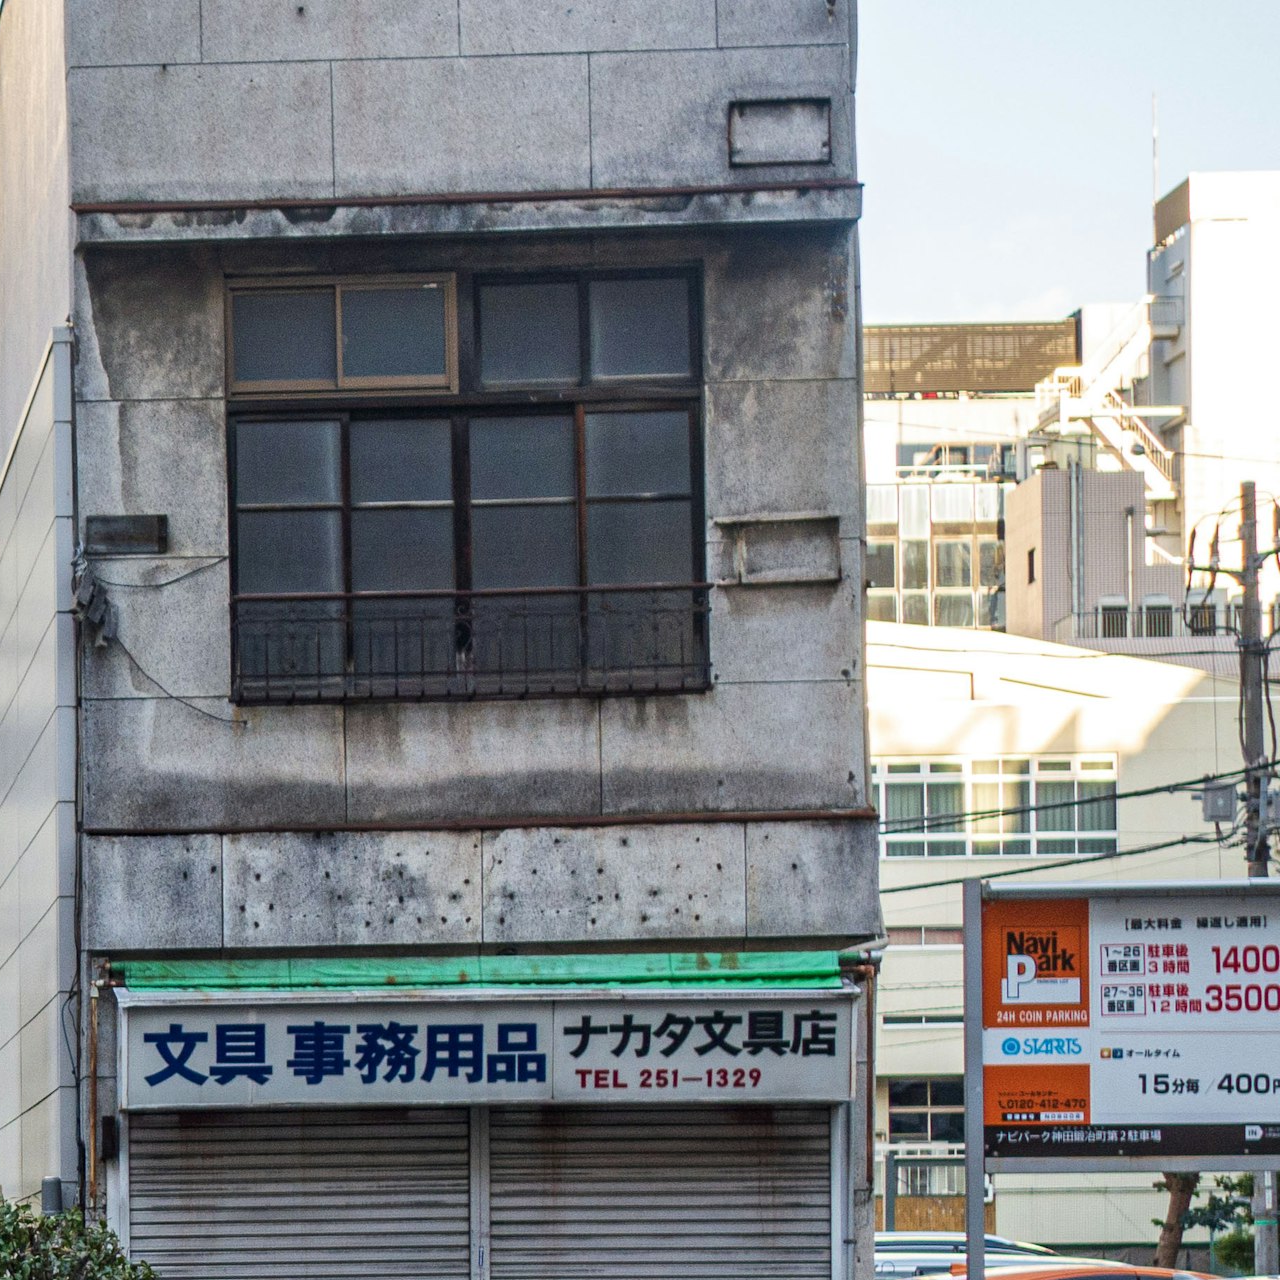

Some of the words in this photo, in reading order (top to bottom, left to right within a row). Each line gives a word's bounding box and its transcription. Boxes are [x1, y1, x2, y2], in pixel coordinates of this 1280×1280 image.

[1006, 931, 1057, 955] Navi
[1147, 943, 1189, 958] 駐車後
[1211, 944, 1280, 974] 1400
[1006, 949, 1075, 999] Park
[1148, 982, 1190, 998] 駐車後
[1205, 983, 1280, 1013] 3500
[997, 1010, 1016, 1024] 24H
[1019, 1010, 1043, 1023] COIN
[1045, 1009, 1088, 1024] PARKING
[562, 1009, 839, 1060] ナカタ文具店
[142, 1021, 274, 1088] 文具
[285, 1020, 547, 1085] 事務用品
[1126, 1048, 1181, 1060] オールタイム
[574, 1068, 629, 1090] TEL
[1247, 1129, 1258, 1138] IN
